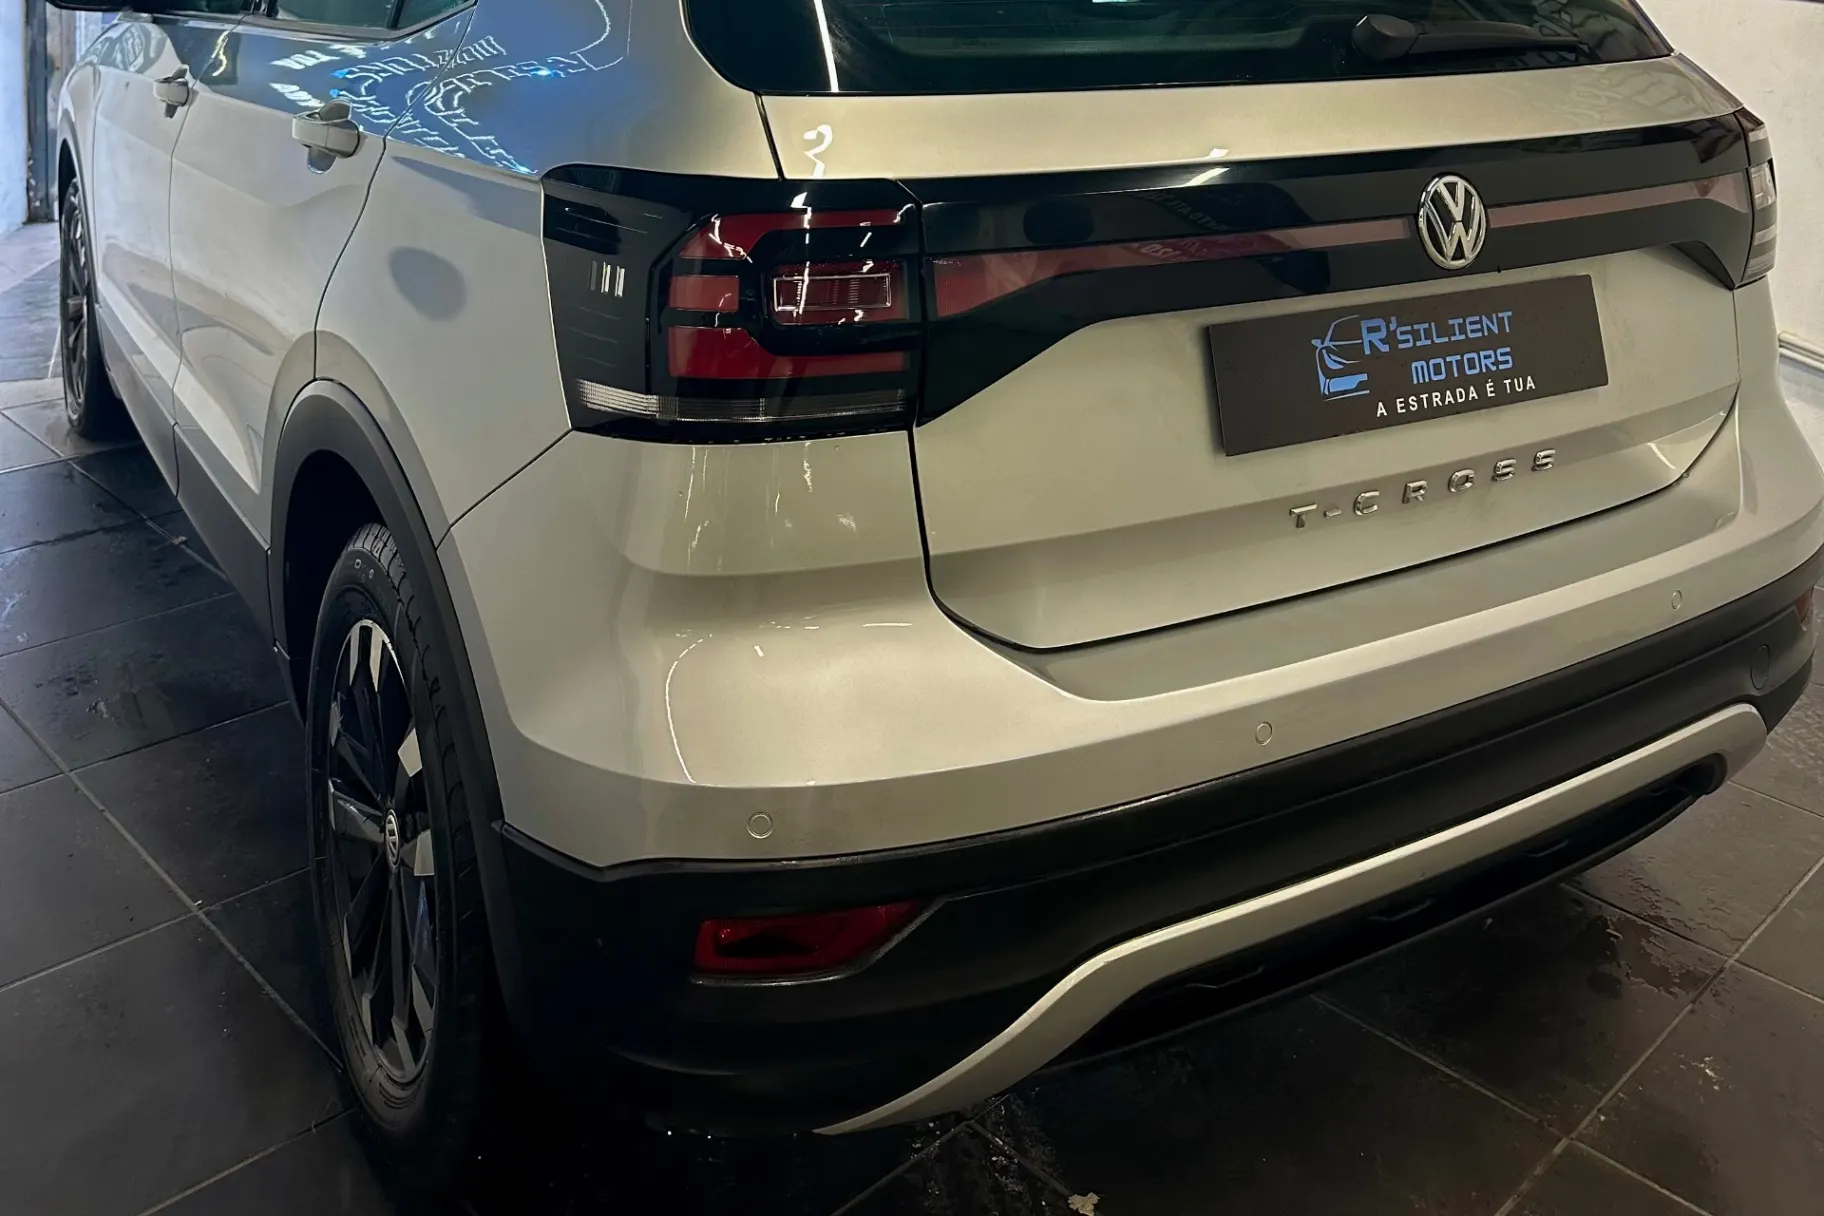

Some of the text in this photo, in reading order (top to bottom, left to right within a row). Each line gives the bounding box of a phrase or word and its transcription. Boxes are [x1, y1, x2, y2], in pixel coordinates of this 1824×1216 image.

[1360, 311, 1513, 355] R'SILIENT
[1411, 346, 1514, 385] MOTORS
[1376, 375, 1537, 418] A ESTRADA É TUA
[1289, 449, 1556, 528] T-CROSS
